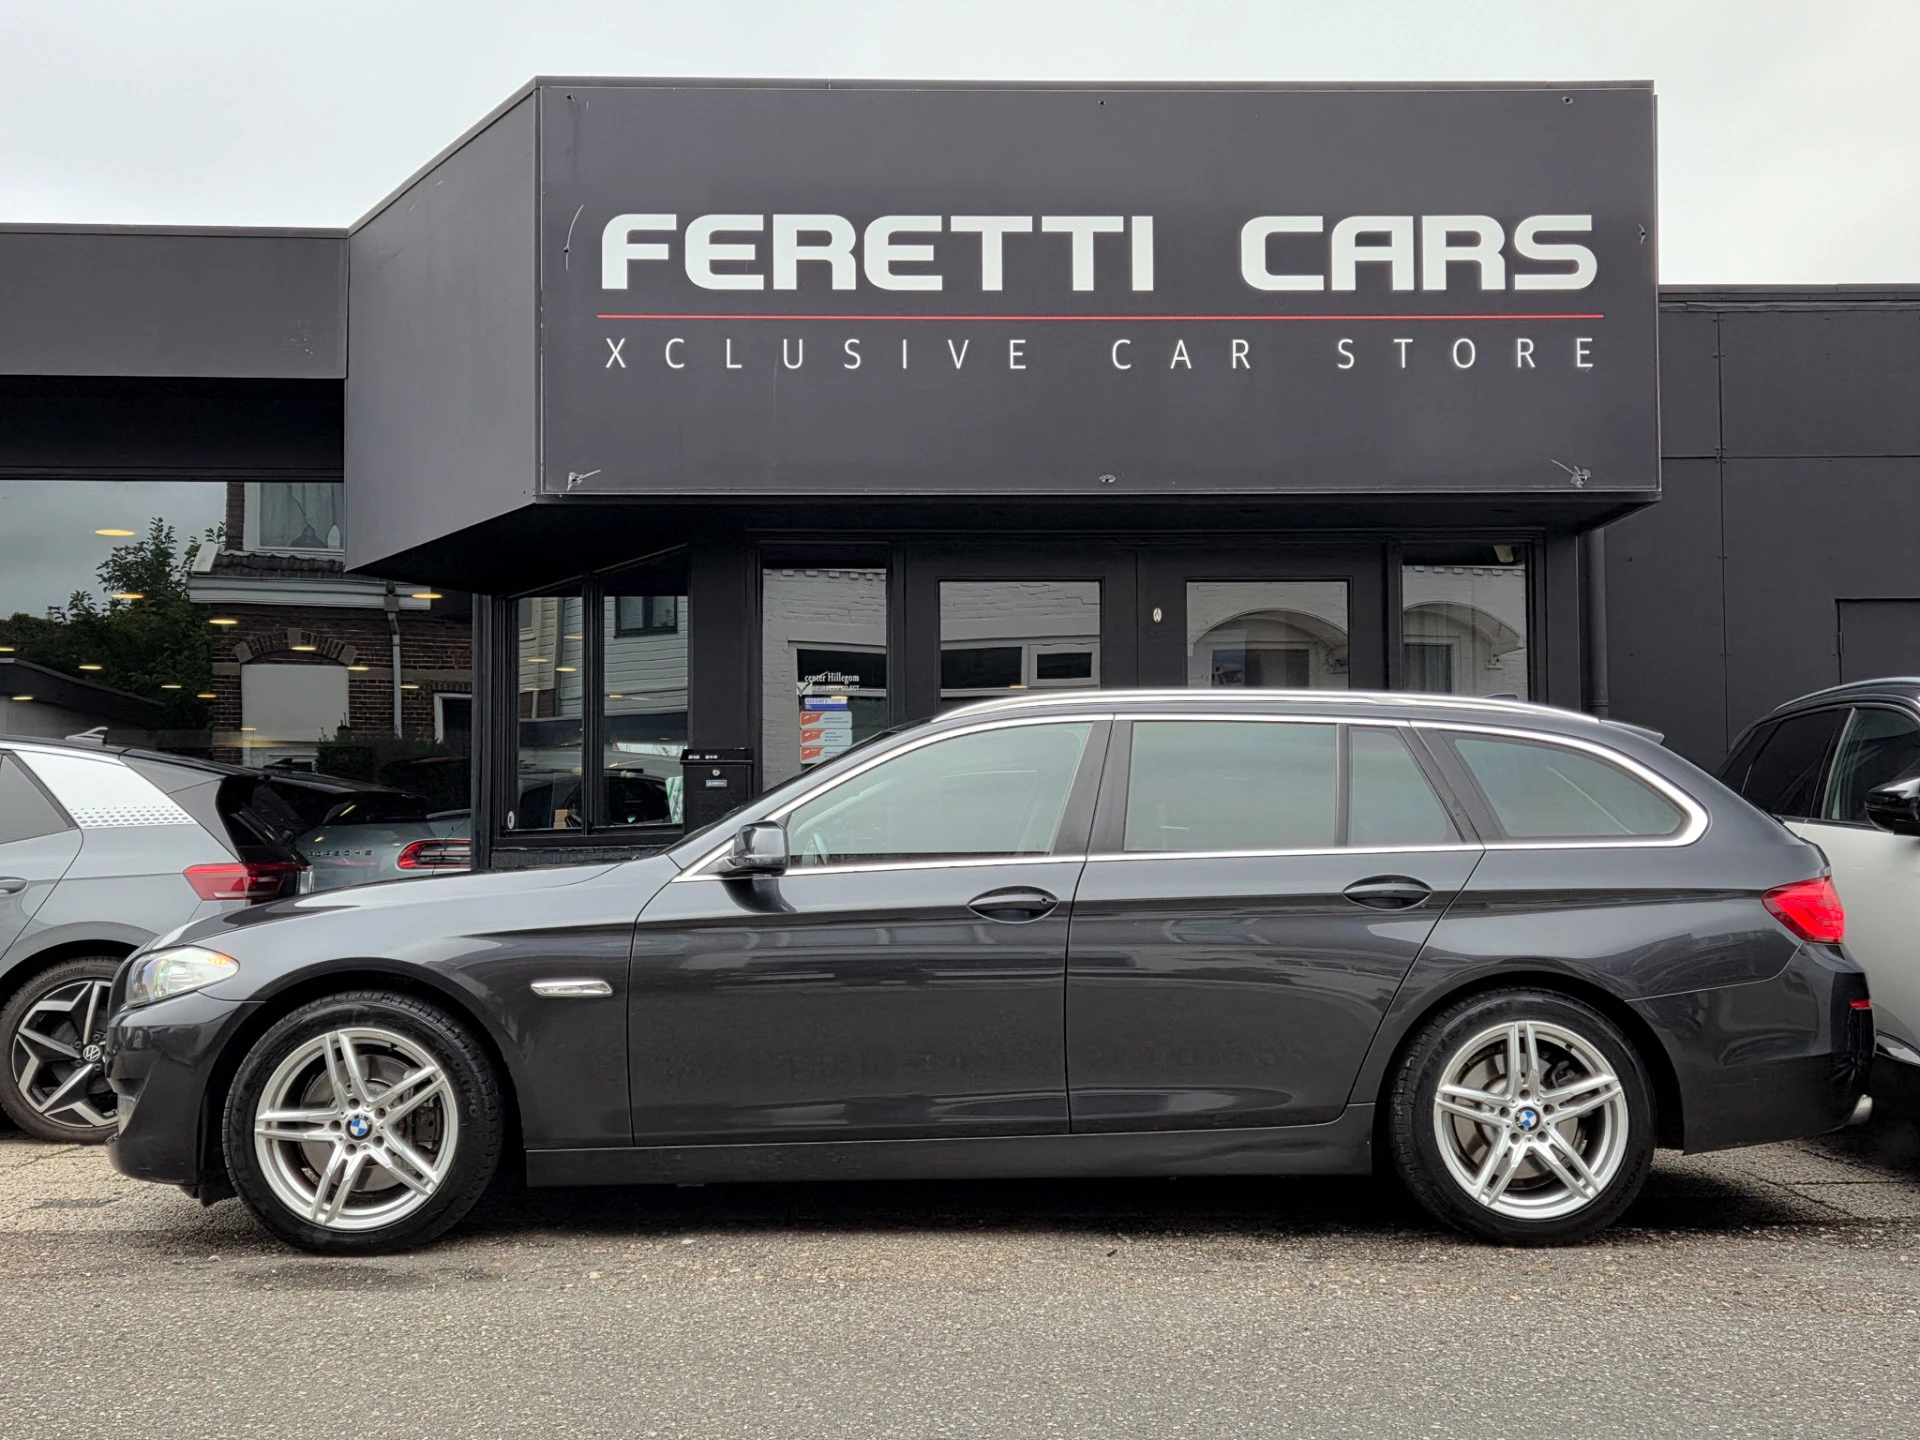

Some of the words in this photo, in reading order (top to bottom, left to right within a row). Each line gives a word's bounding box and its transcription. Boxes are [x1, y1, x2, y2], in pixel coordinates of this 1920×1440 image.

[602, 213, 1154, 291] FERETTI
[1241, 214, 1598, 291] CARS
[605, 337, 1028, 370] XCLUSIVE
[1111, 338, 1251, 370] CAR
[1337, 337, 1594, 369] STORE
[827, 671, 860, 685] Hillegom
